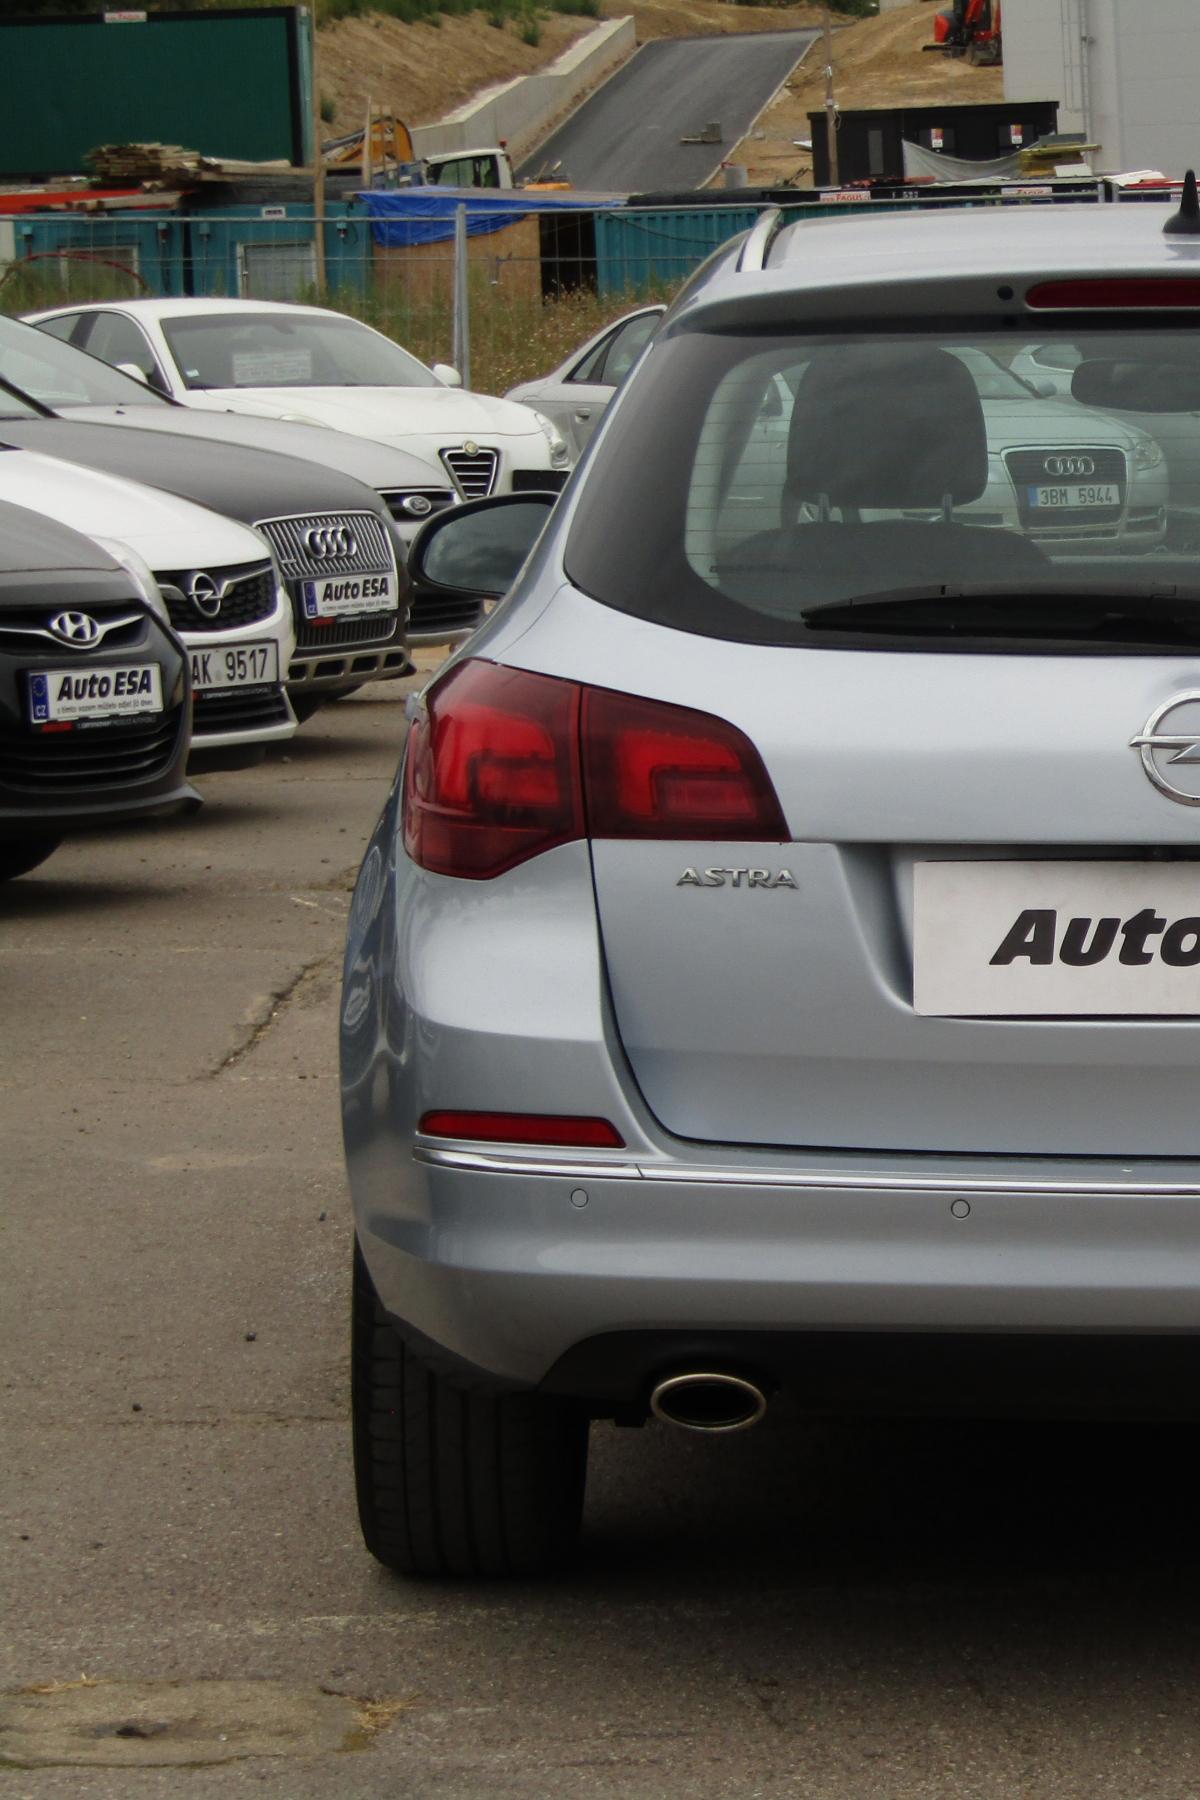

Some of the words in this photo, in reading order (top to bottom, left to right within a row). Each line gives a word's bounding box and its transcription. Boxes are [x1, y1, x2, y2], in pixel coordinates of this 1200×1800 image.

[1040, 488, 1069, 506] 3BM
[1078, 486, 1113, 505] 5944
[322, 580, 361, 602] Auto
[361, 576, 390, 598] ESA
[191, 653, 213, 685] AK
[225, 647, 268, 681] 9517
[56, 673, 112, 702] Auto
[113, 669, 153, 697] ESA
[35, 704, 47, 717] CZ
[676, 867, 800, 890] ASTRA
